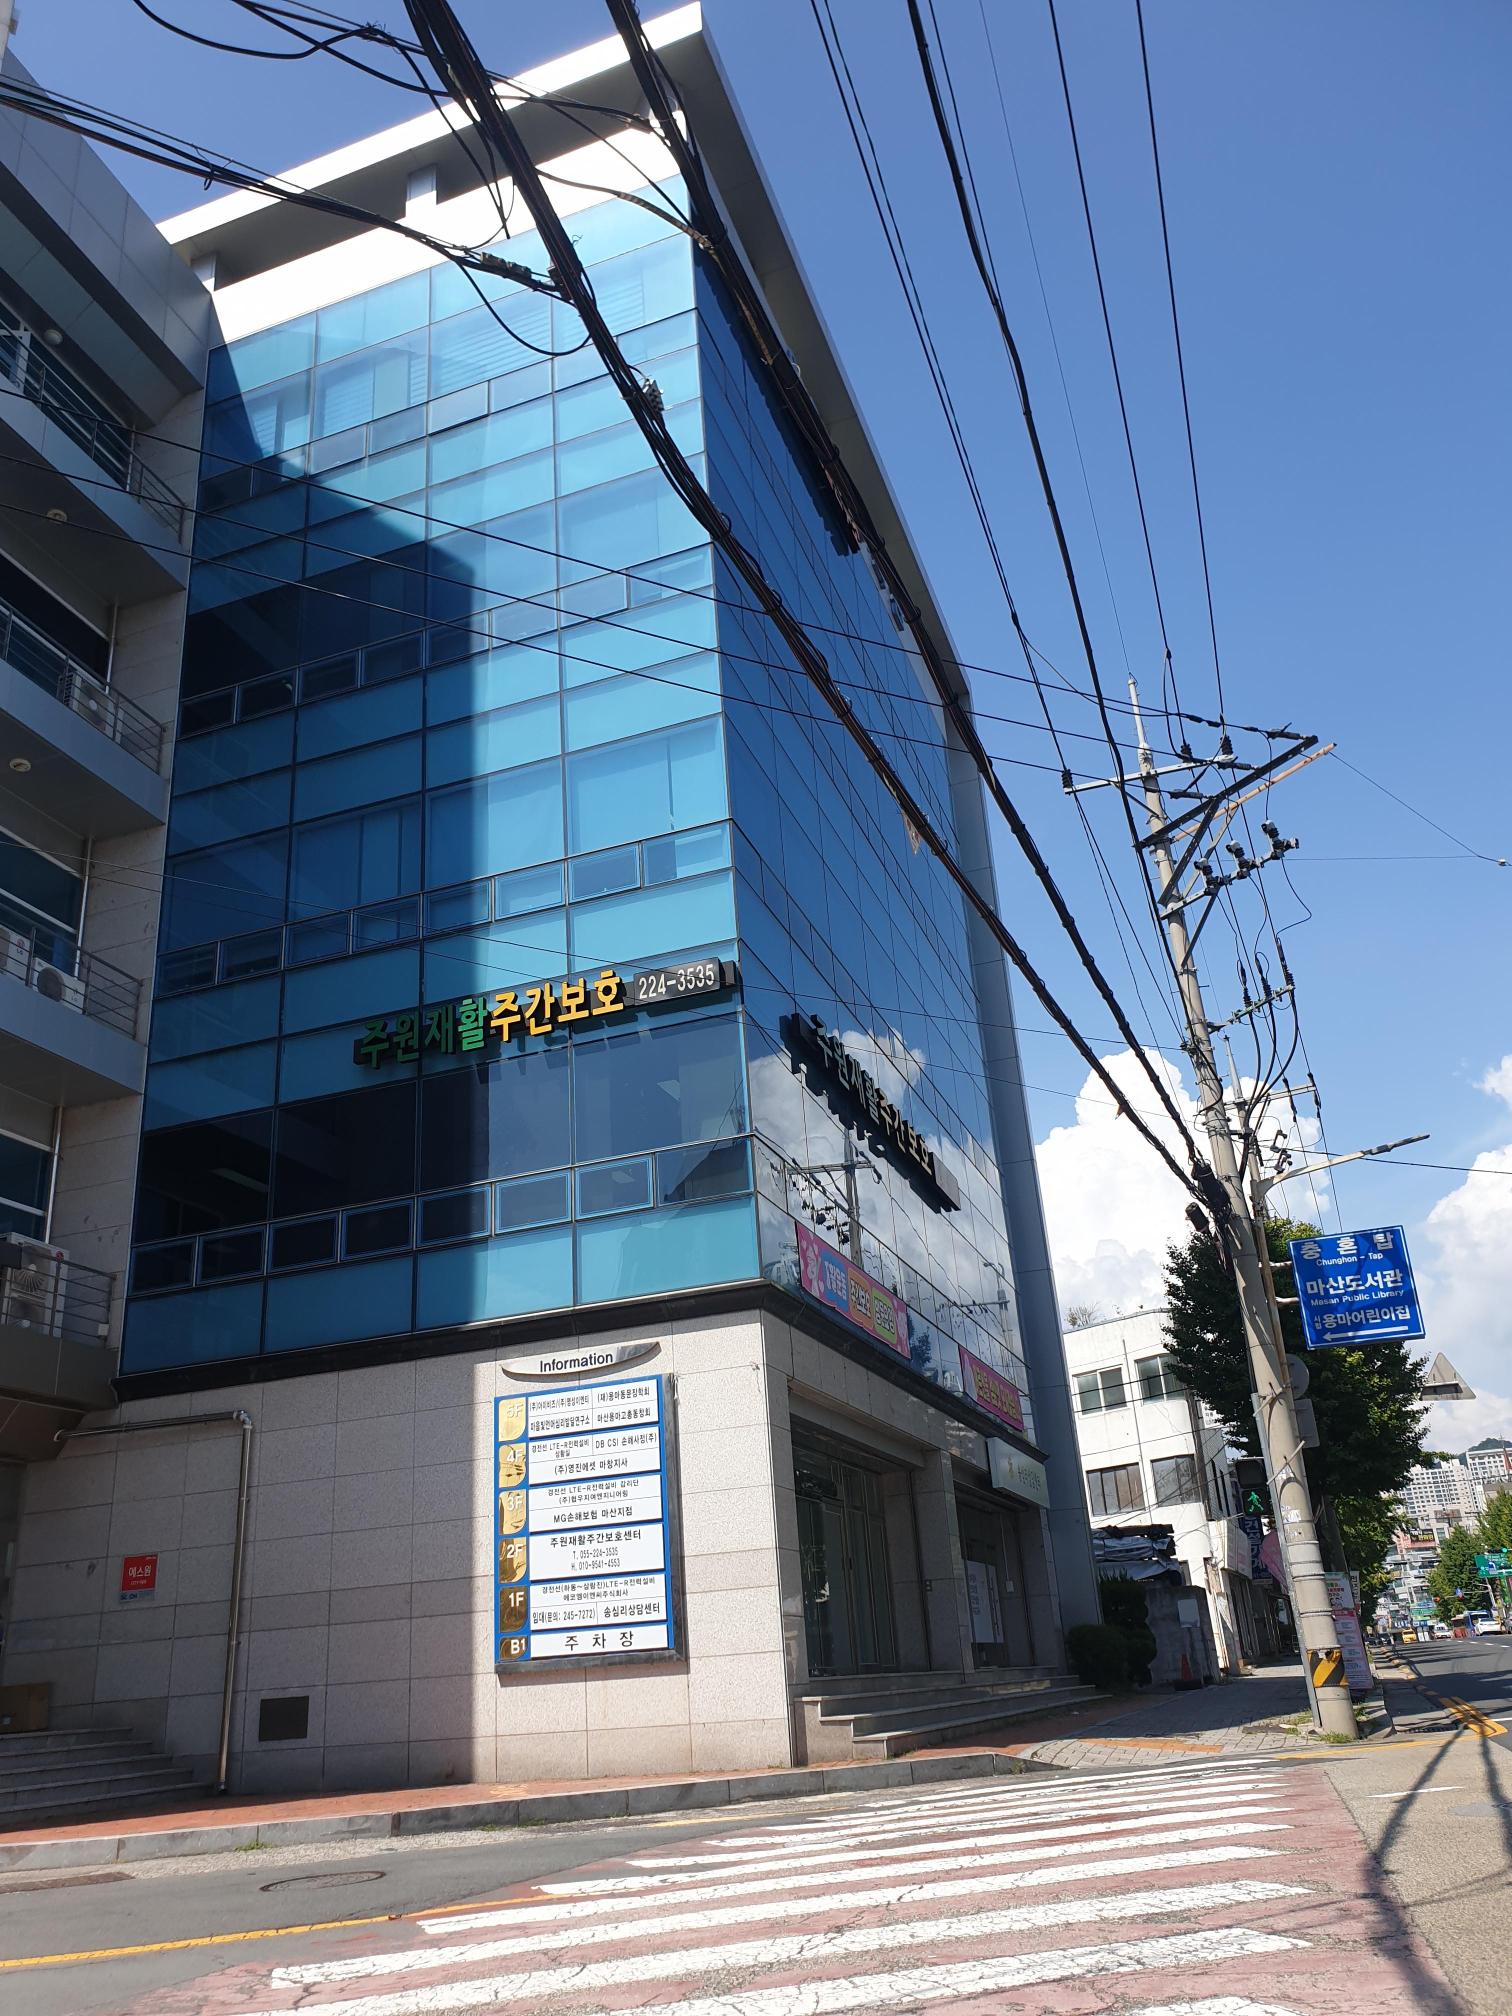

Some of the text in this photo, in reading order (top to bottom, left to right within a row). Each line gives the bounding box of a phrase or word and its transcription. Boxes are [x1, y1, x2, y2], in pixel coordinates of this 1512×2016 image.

[361, 963, 715, 1069] 주원재활주간보호 224-3535
[1316, 1255, 1357, 1266] Chunghon
[1368, 1252, 1383, 1261] Tap
[1306, 1269, 1403, 1296] 마산도서관
[1311, 1289, 1404, 1307] Masan Public Library
[1323, 1305, 1411, 1329] 용마어린이집
[540, 1353, 614, 1373] Information
[595, 1440, 606, 1449] DB
[607, 1438, 619, 1447] CSI
[506, 1449, 522, 1463] 4F
[600, 1459, 628, 1470] 마창지사
[507, 1496, 523, 1511] 3F
[553, 1506, 633, 1524] MG손해보험 마산지점
[550, 1529, 641, 1548] 주원재활주간보호센터
[506, 1544, 523, 1558] 2F
[128, 1564, 152, 1578] 에스원
[508, 1591, 524, 1608] 1F
[563, 1607, 596, 1621] 245-7272)
[603, 1602, 660, 1618] 송심리상담센터
[510, 1638, 526, 1655] B1
